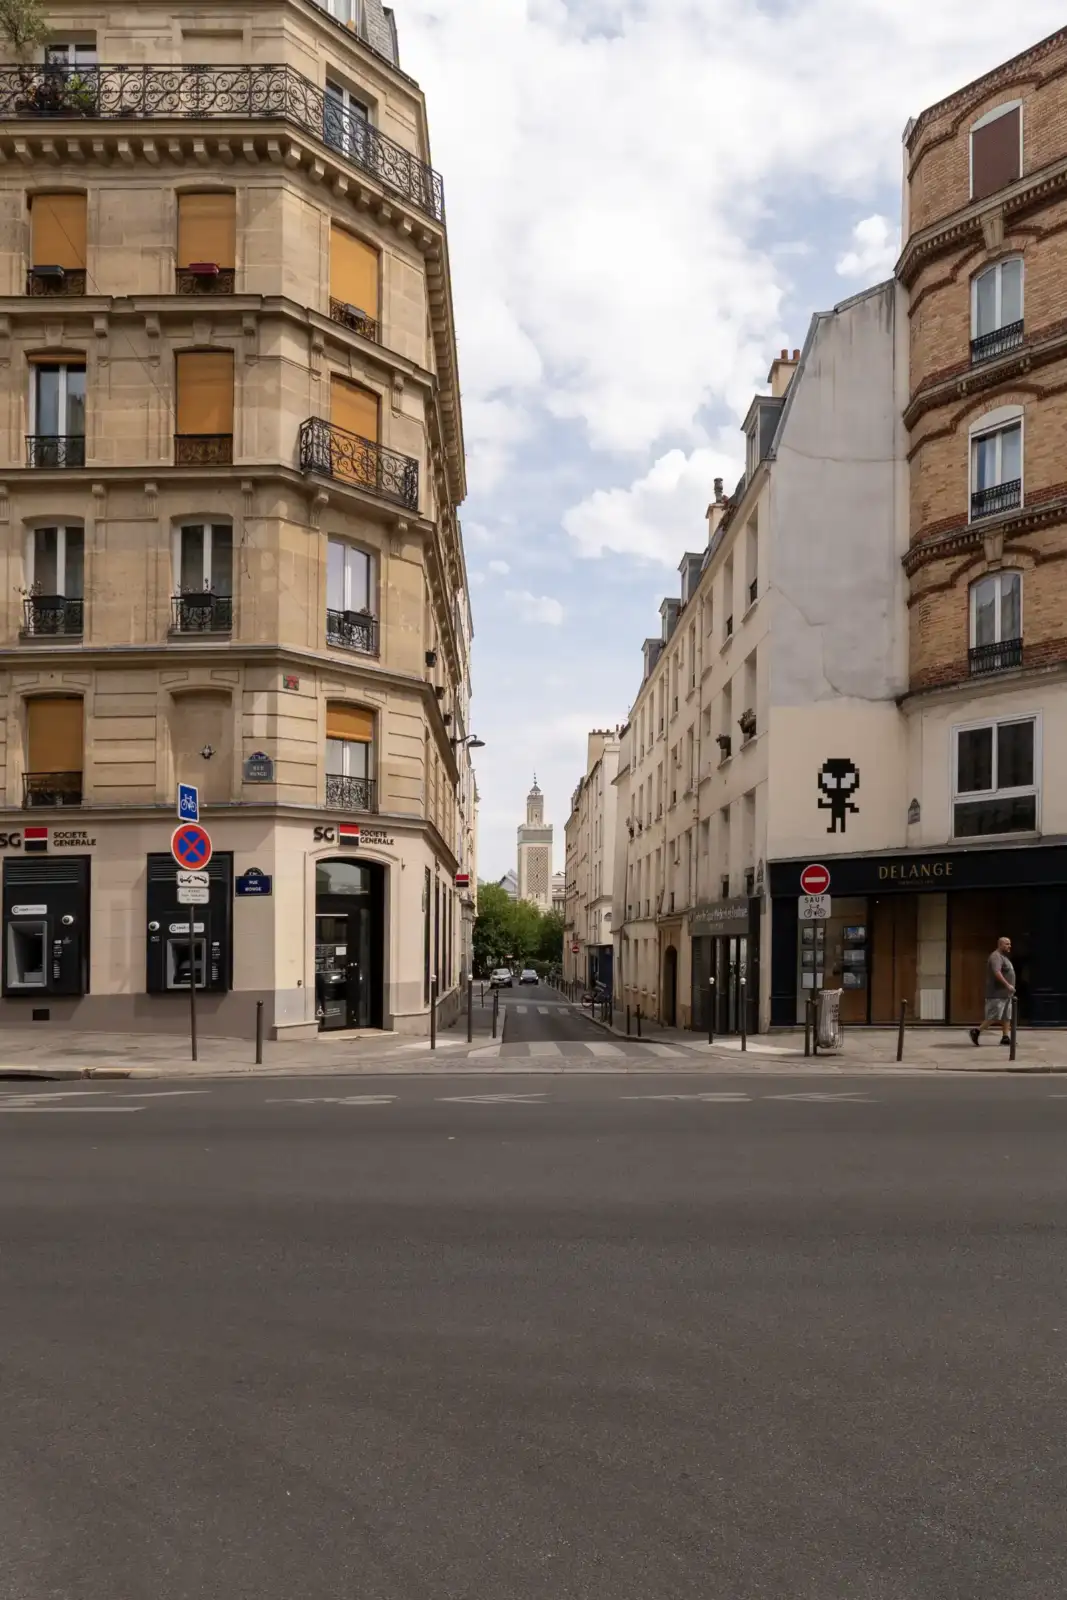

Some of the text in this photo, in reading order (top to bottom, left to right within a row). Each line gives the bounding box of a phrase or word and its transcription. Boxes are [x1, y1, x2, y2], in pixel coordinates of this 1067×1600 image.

[53, 831, 87, 839] SOCIETE
[313, 826, 334, 841] SG
[360, 829, 387, 838] SOCIETE
[0, 832, 21, 848] SG
[53, 839, 96, 847] GENERALE
[360, 837, 394, 846] GENERALE
[878, 862, 953, 879] DELANGE
